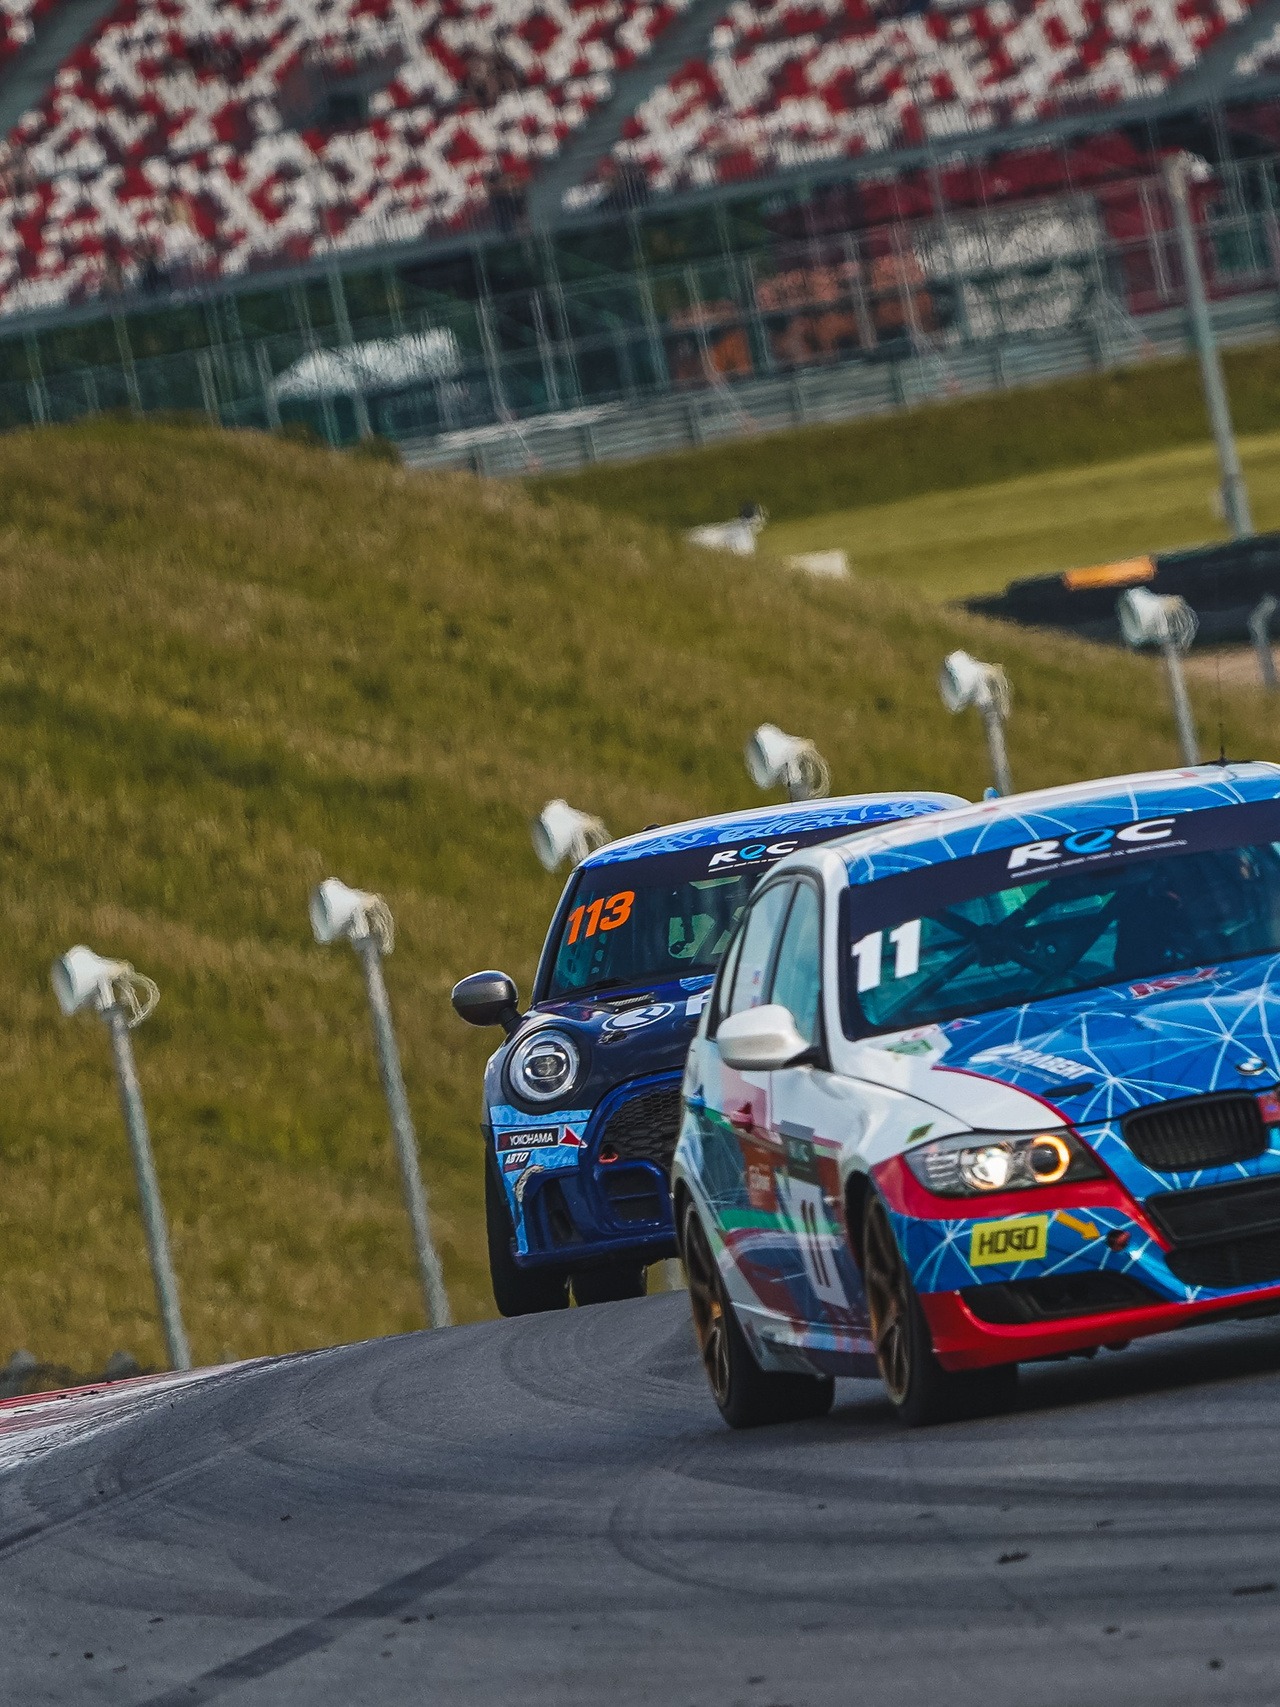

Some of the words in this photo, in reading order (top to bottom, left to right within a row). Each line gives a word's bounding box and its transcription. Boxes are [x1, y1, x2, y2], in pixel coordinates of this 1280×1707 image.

[567, 890, 635, 946] 113
[851, 918, 922, 994] 11
[509, 1133, 554, 1146] YOKOHAMA
